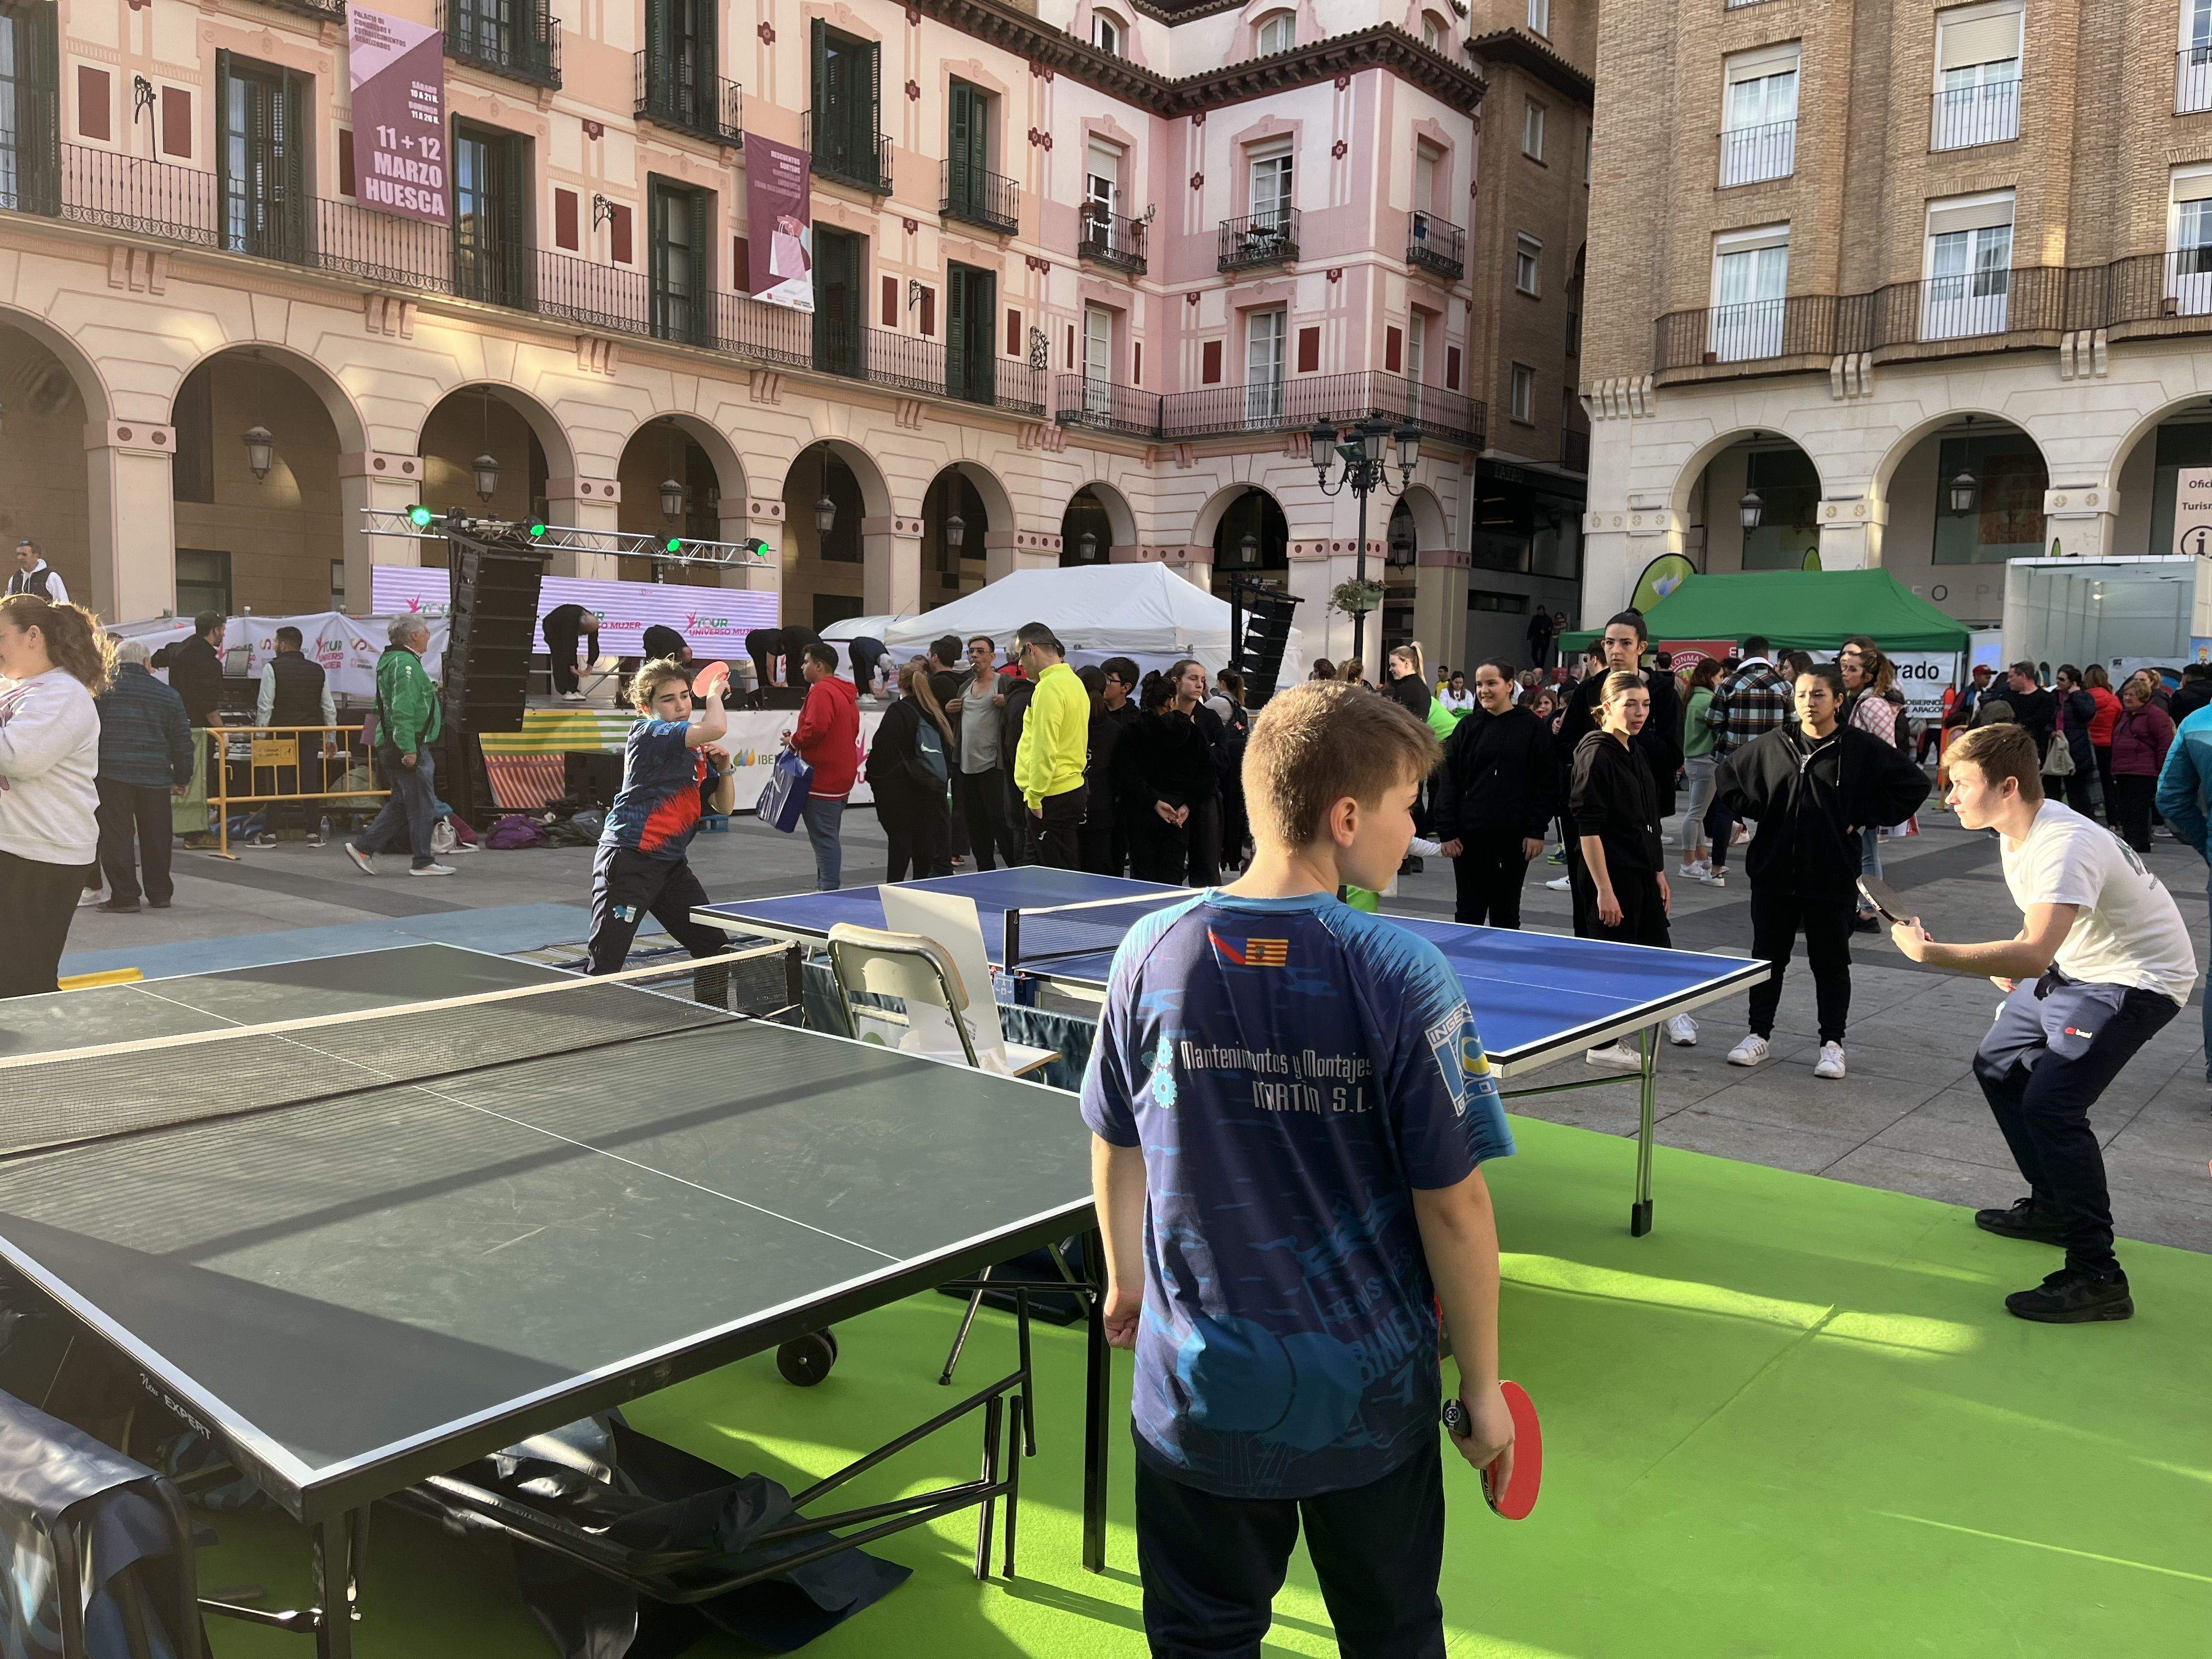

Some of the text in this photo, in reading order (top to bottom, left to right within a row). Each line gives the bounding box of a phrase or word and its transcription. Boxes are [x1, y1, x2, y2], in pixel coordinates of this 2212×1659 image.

[376, 125, 441, 161] 11 + 12
[374, 151, 443, 189] MARZO
[365, 177, 446, 216] HUESCA
[2189, 479, 2212, 489] Ofici
[1894, 661, 1939, 679] rado
[1292, 1055, 1302, 1080] y
[1302, 1048, 1373, 1085] Montajes
[164, 1394, 212, 1440] EXPERT
